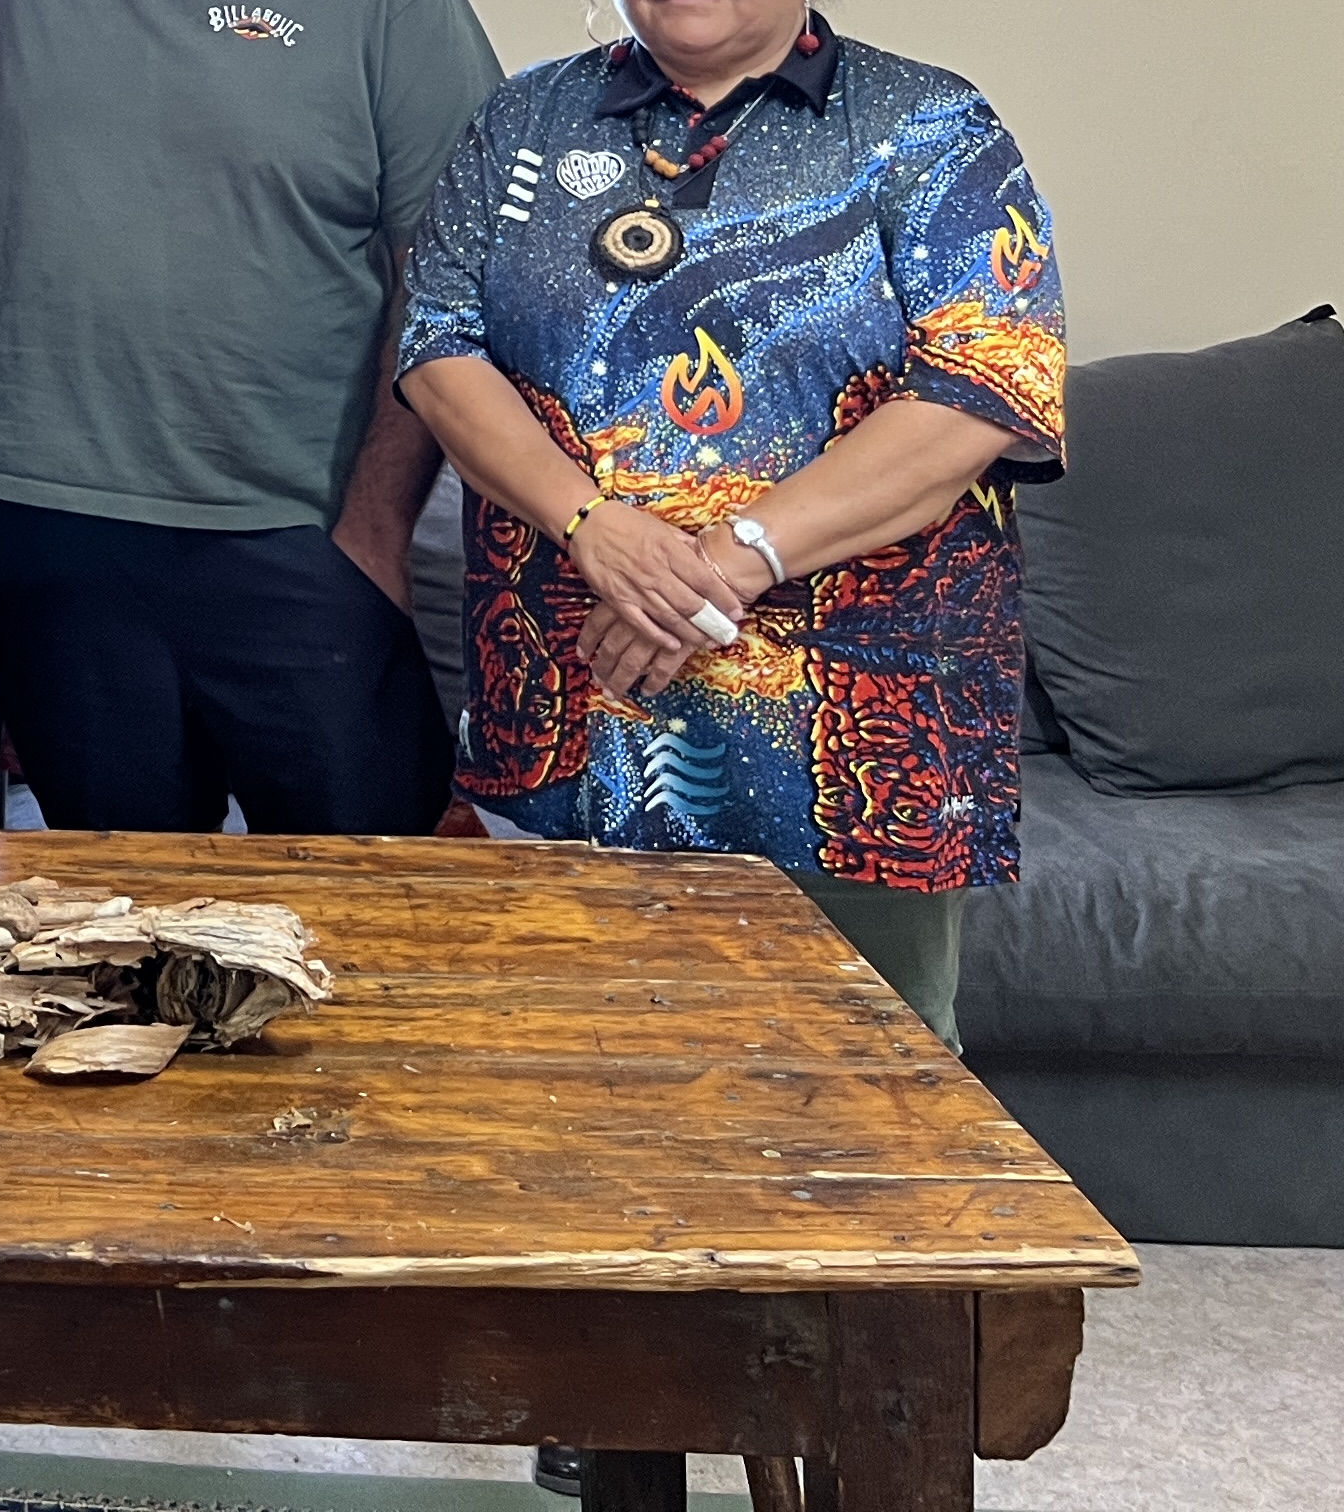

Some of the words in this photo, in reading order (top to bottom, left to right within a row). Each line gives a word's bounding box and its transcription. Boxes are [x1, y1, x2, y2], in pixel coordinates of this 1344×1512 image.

[207, 4, 304, 47] BILLABONG
[560, 154, 619, 183] NAIDOC
[568, 174, 612, 196] 2021
